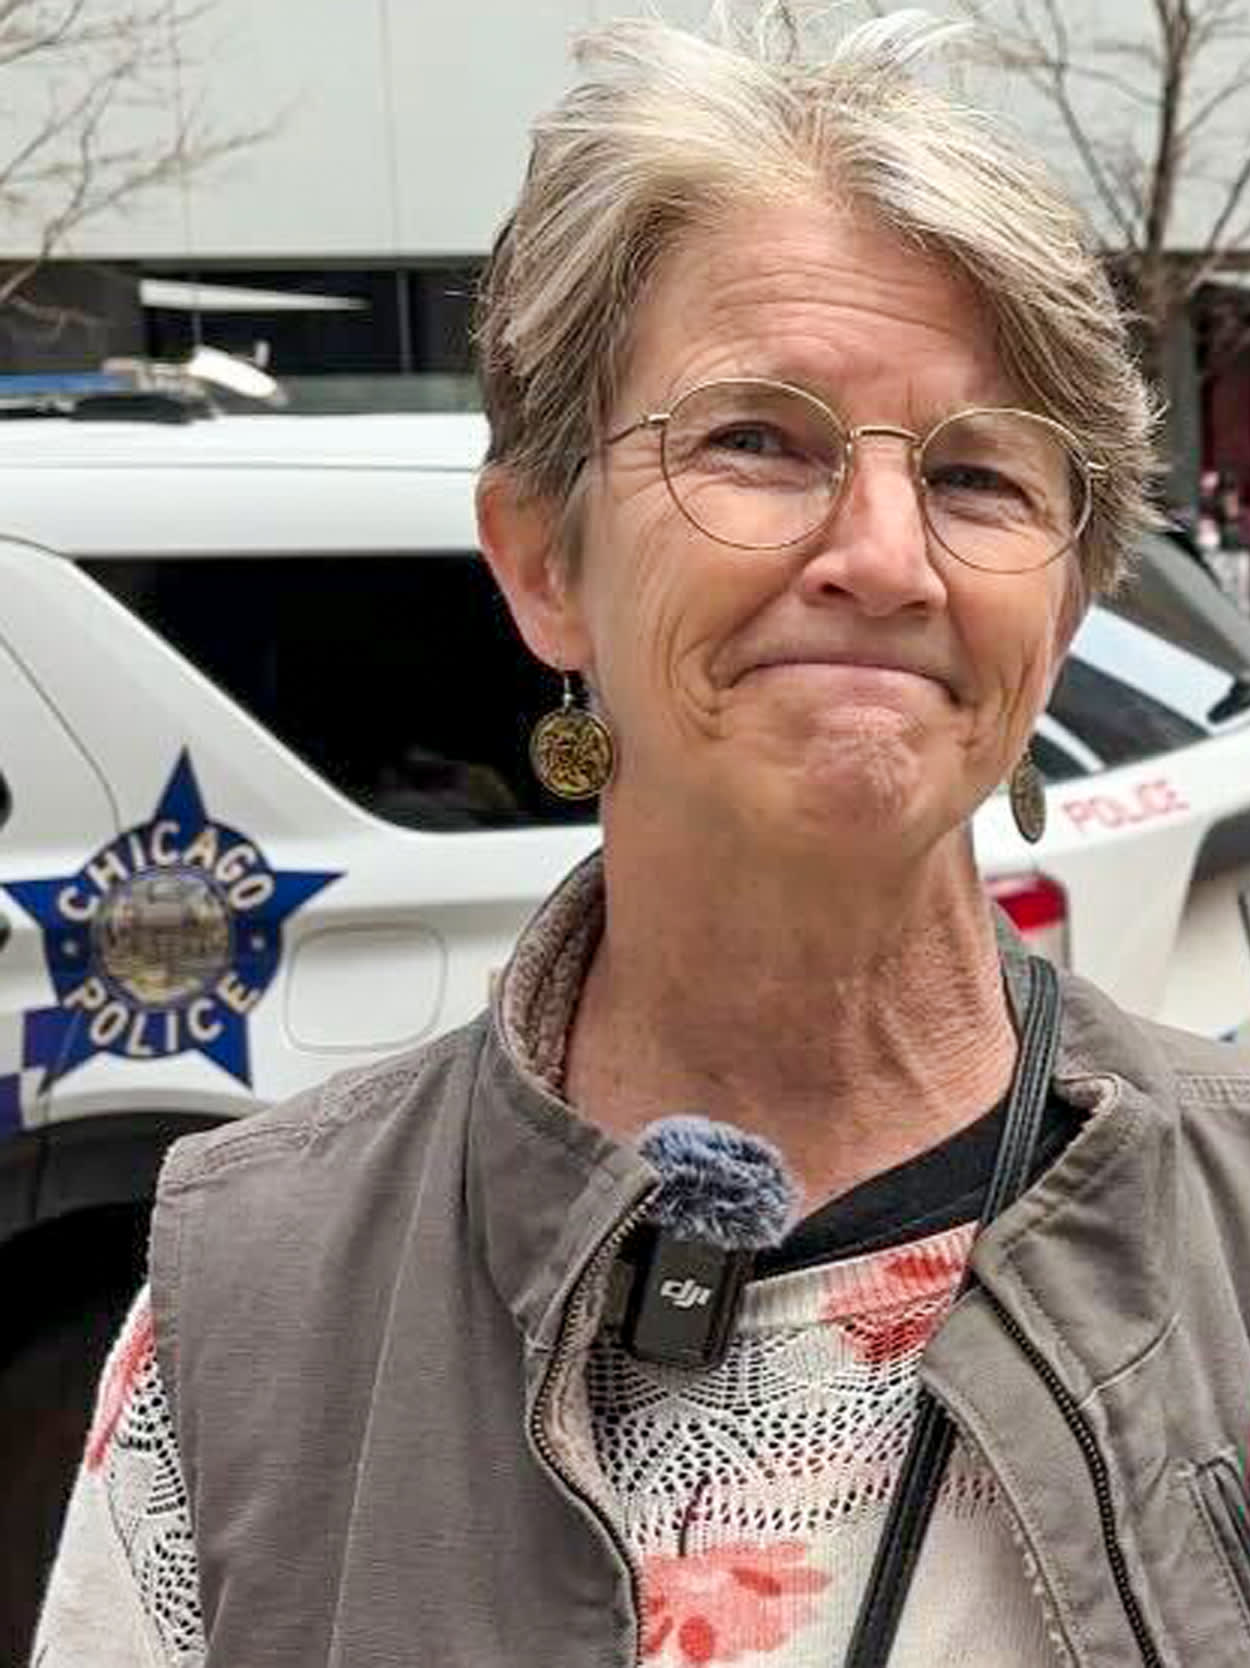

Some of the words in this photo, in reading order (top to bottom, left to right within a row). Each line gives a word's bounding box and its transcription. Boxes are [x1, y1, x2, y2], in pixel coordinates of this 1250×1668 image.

[1061, 778, 1190, 834] POLICE
[57, 819, 276, 921] CHICAGO
[64, 971, 264, 1054] POLICE
